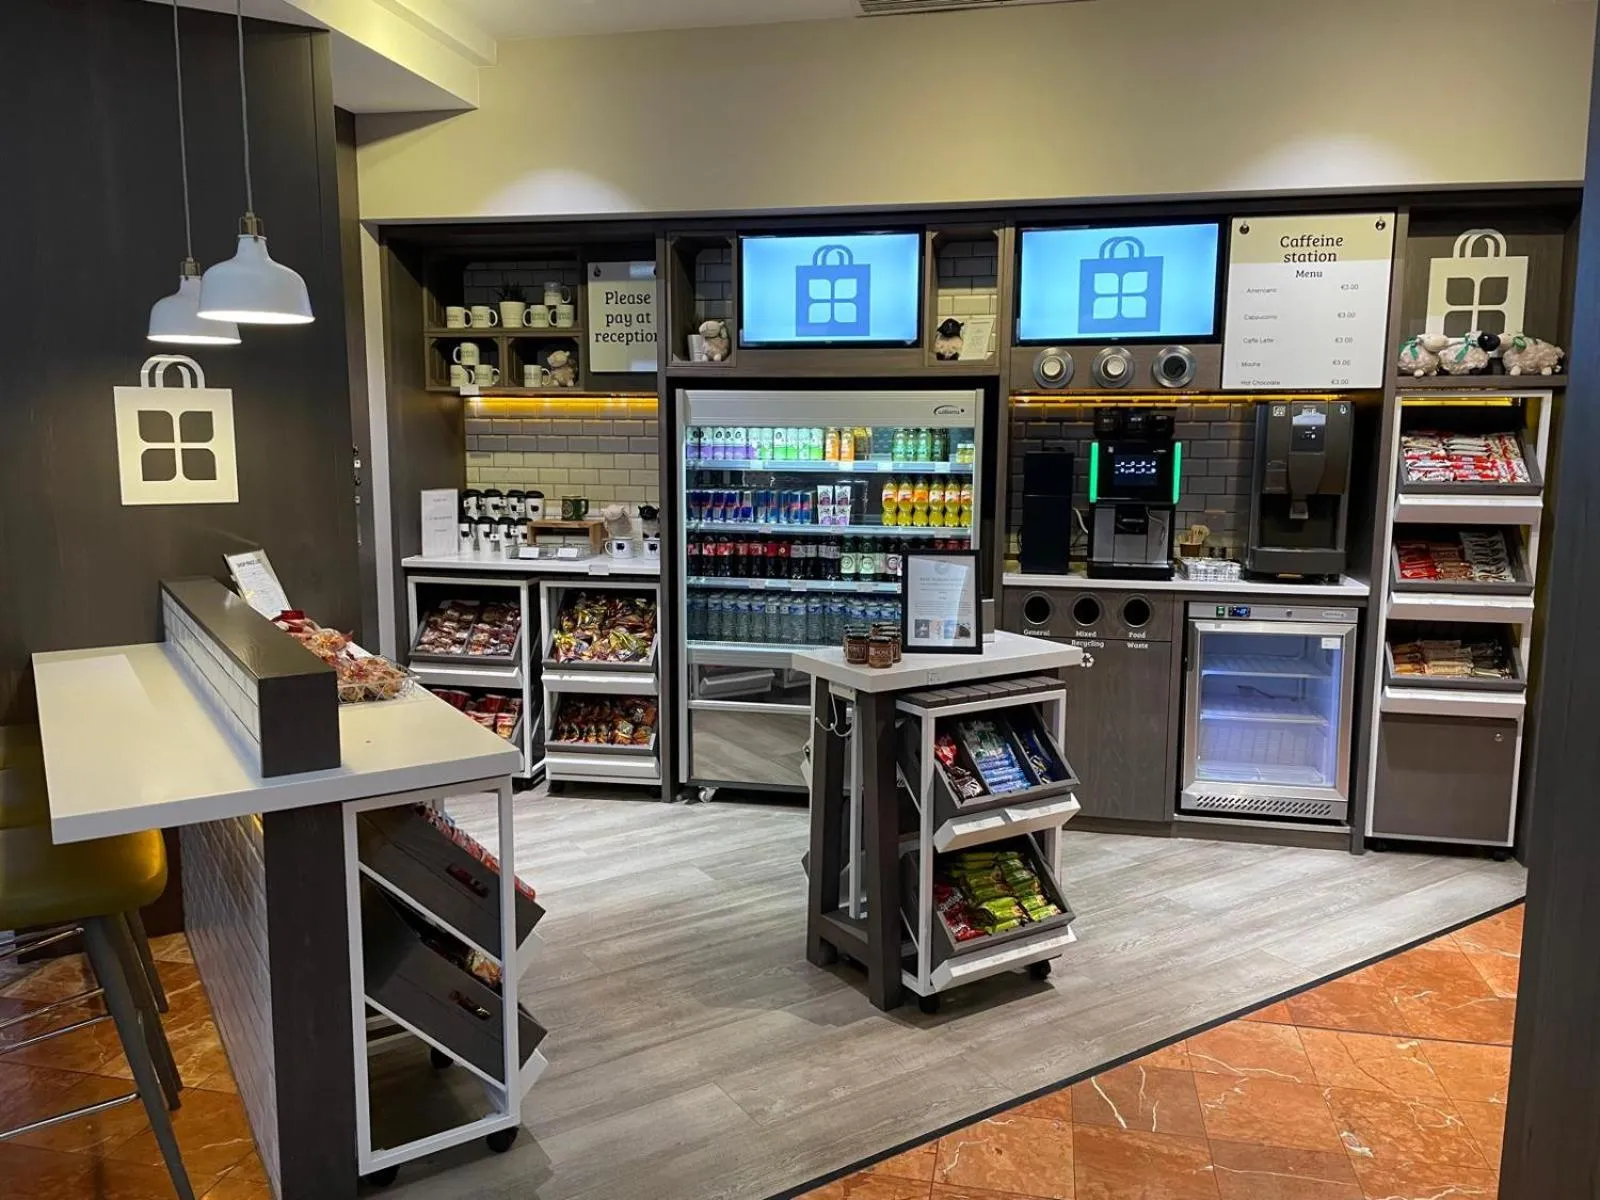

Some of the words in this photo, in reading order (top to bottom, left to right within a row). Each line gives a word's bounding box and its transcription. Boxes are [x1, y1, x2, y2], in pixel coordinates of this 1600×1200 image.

[1280, 234, 1344, 248] Caffeine
[1283, 250, 1337, 263] station
[1295, 270, 1323, 278] Menu
[605, 291, 651, 305] Please
[606, 312, 633, 327] pay
[636, 312, 651, 324] at
[1075, 630, 1097, 638] Mixed
[1128, 631, 1146, 639] Food
[1071, 640, 1104, 648] Recycling
